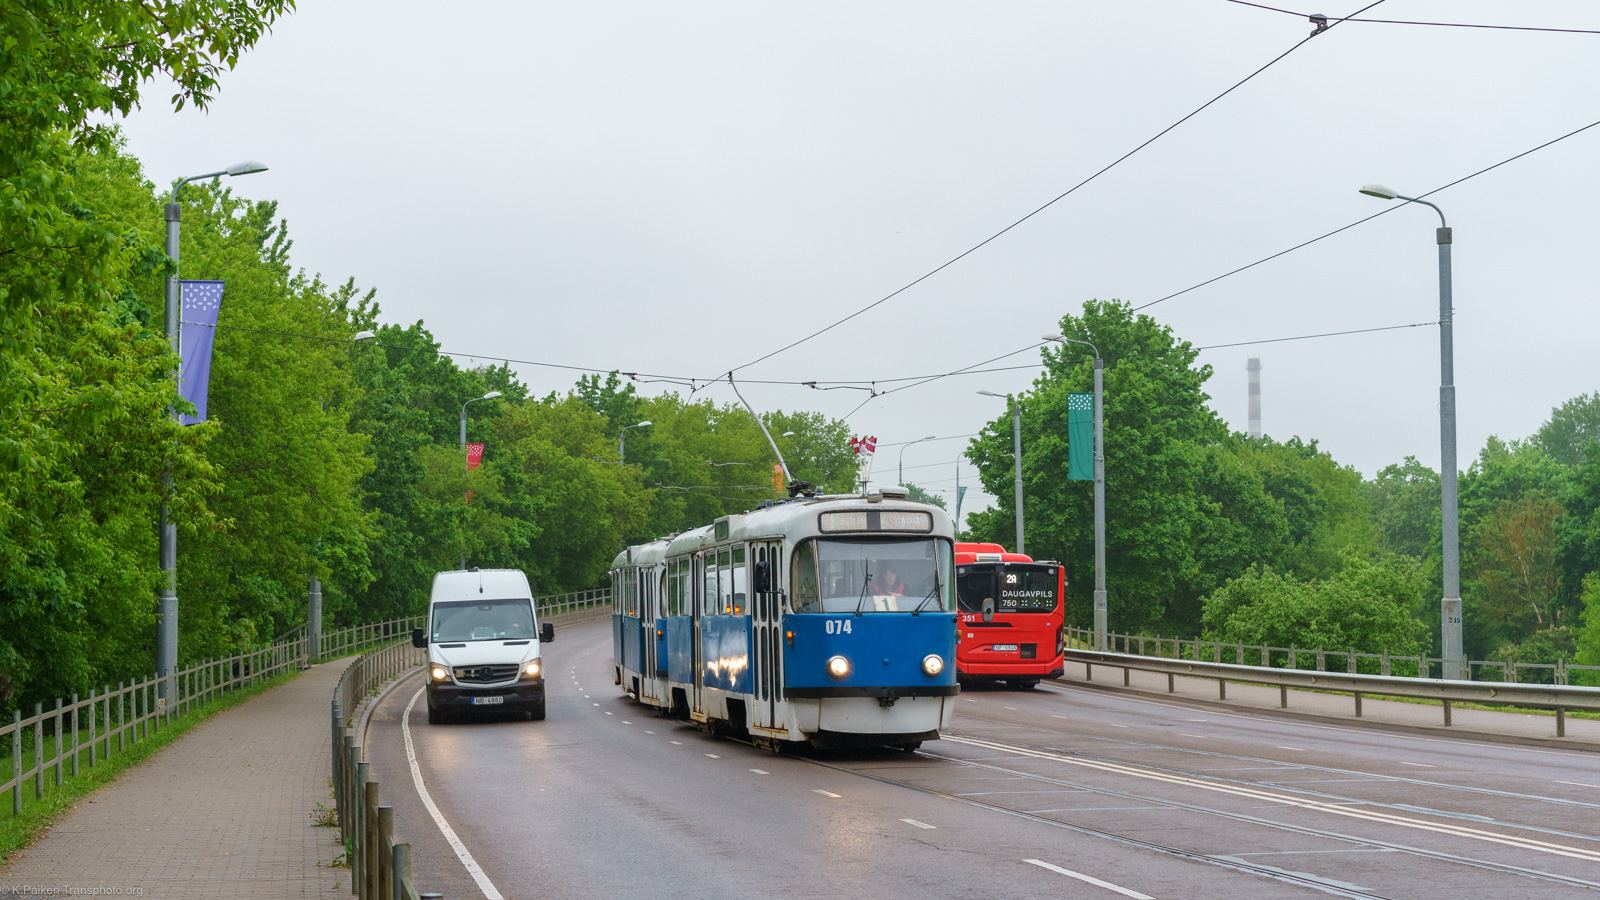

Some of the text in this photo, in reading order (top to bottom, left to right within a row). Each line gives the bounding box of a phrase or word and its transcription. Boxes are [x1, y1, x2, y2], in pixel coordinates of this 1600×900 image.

[1006, 574, 1017, 584] 2A
[1002, 590, 1053, 598] DAUGAVPILS
[881, 598, 890, 611] 1
[1002, 599, 1017, 607] 750
[825, 619, 853, 635] 074
[475, 696, 503, 704] NB-4980
